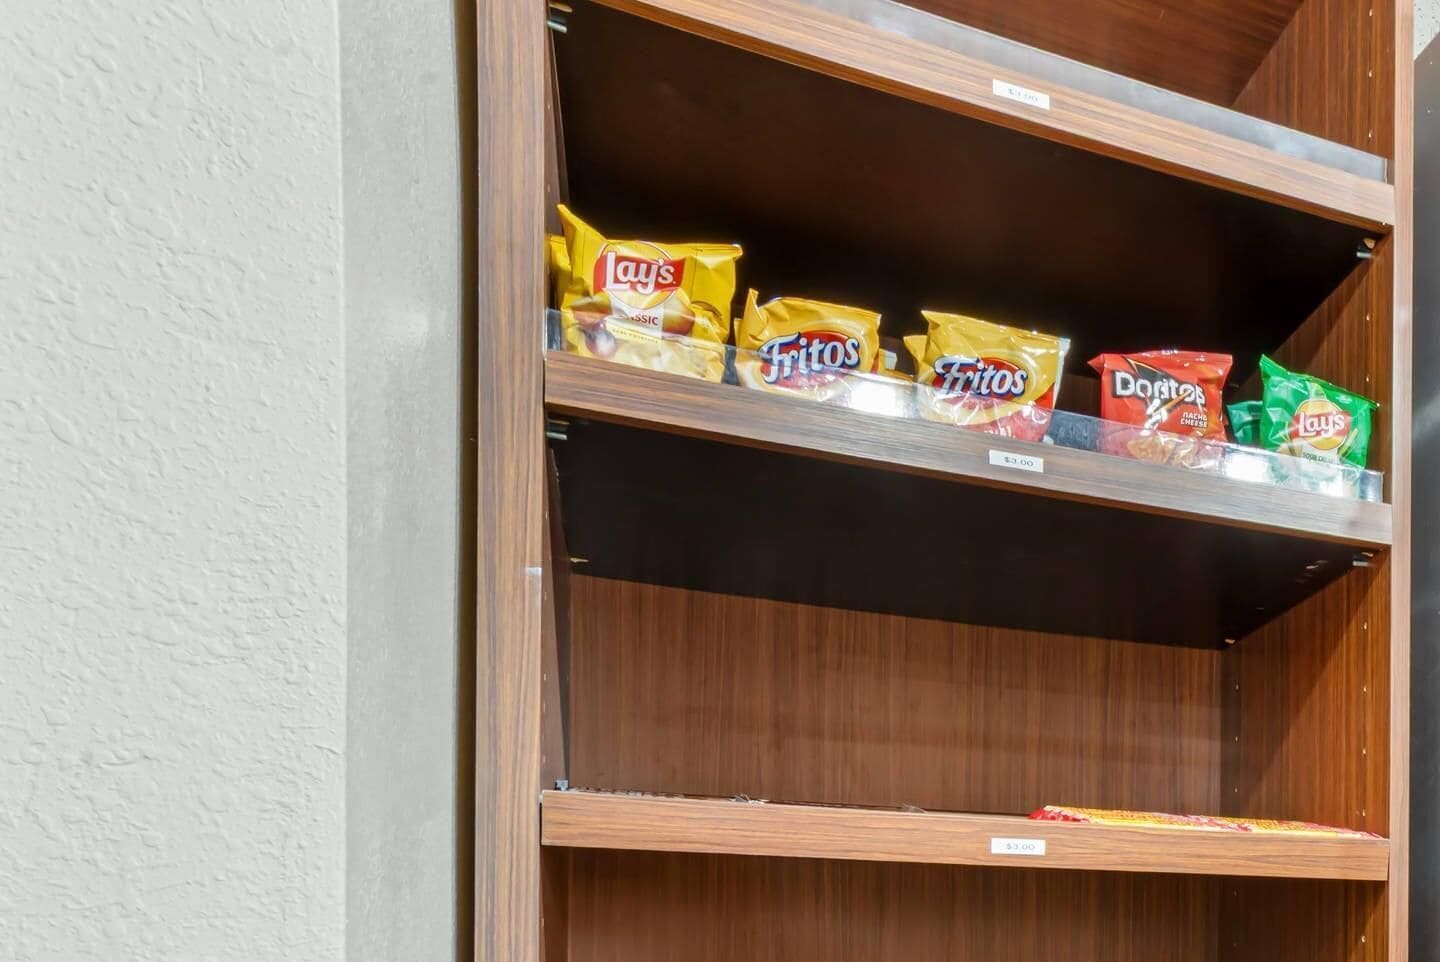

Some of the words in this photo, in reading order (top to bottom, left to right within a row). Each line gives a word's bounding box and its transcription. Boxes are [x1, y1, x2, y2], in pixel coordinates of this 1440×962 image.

[606, 251, 678, 296] Lay's
[760, 333, 860, 384] Fritos
[935, 356, 1028, 397] Fritos
[1115, 371, 1206, 405] Doritos
[1180, 418, 1208, 428] CHEESE
[1182, 411, 1208, 421] NACHO
[1298, 411, 1345, 437] Lay's
[1004, 456, 1034, 467] $3.00
